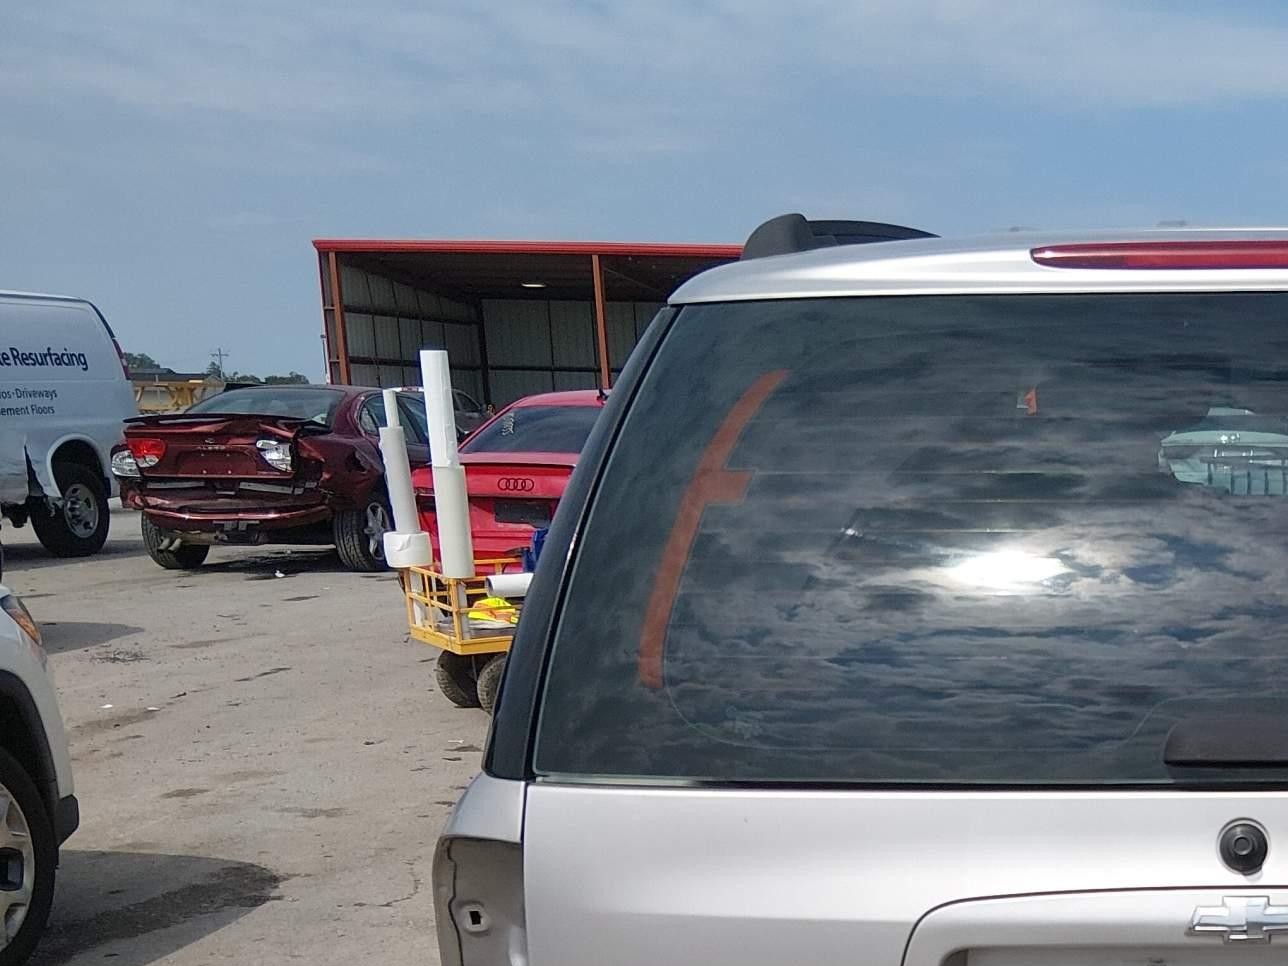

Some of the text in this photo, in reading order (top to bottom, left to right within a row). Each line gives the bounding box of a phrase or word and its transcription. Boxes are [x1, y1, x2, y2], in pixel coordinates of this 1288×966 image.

[9, 347, 88, 371] Resurfacing
[15, 388, 58, 400] Driveways
[0, 404, 55, 416] ement Floors
